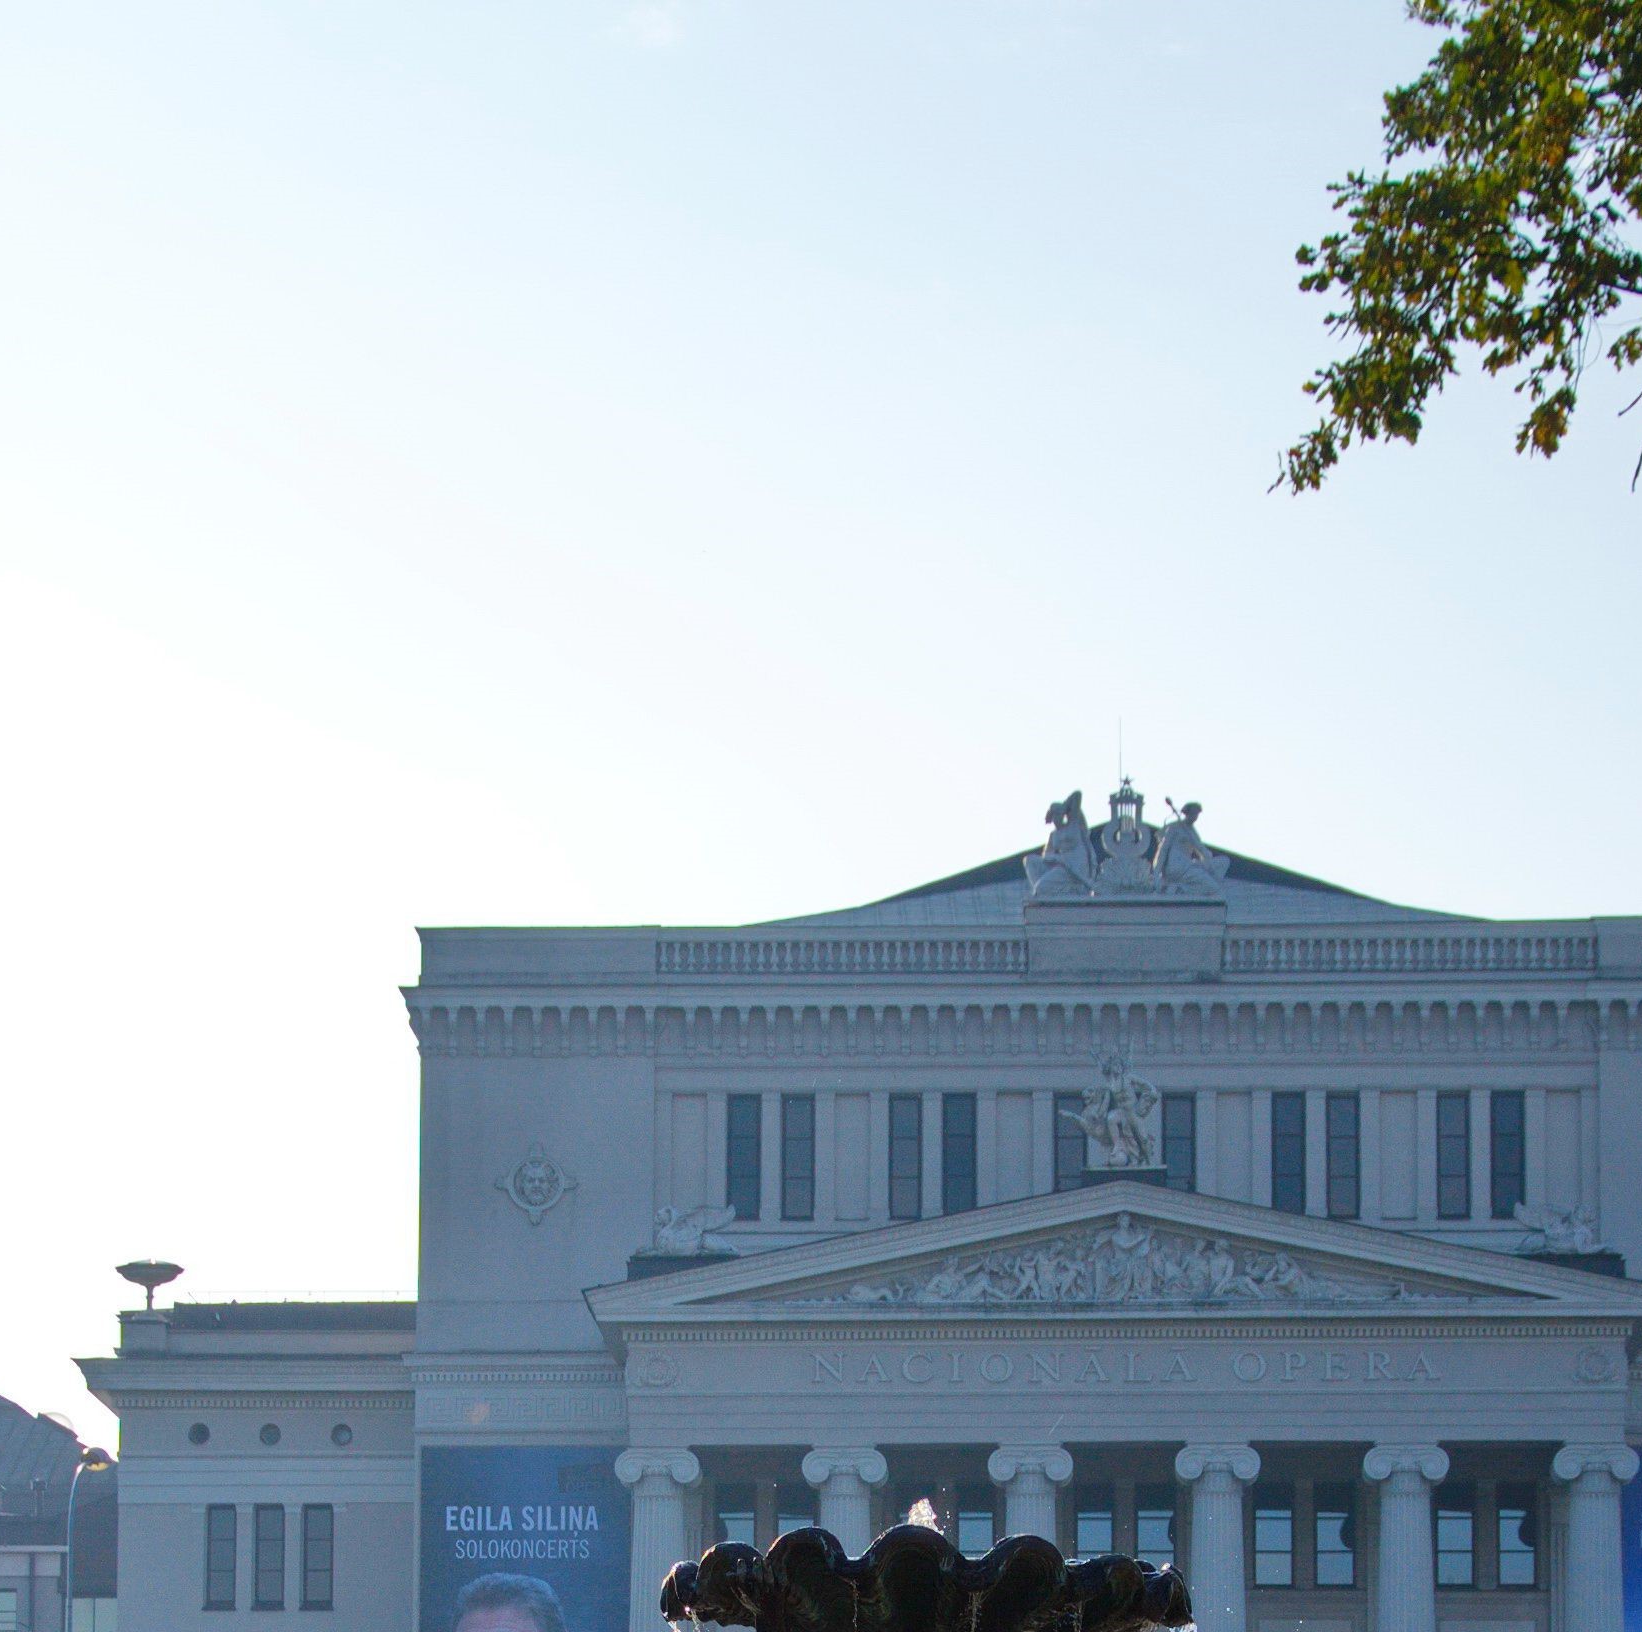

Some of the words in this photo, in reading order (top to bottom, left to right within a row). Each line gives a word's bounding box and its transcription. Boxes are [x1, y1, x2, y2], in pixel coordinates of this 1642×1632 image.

[811, 1347, 1199, 1384] NACIONĀLĀ
[1232, 1350, 1442, 1384] OPERA
[445, 1505, 513, 1531] EGILA
[521, 1505, 599, 1537] SILIŅA
[455, 1539, 590, 1559] SOLOKONCERTS
